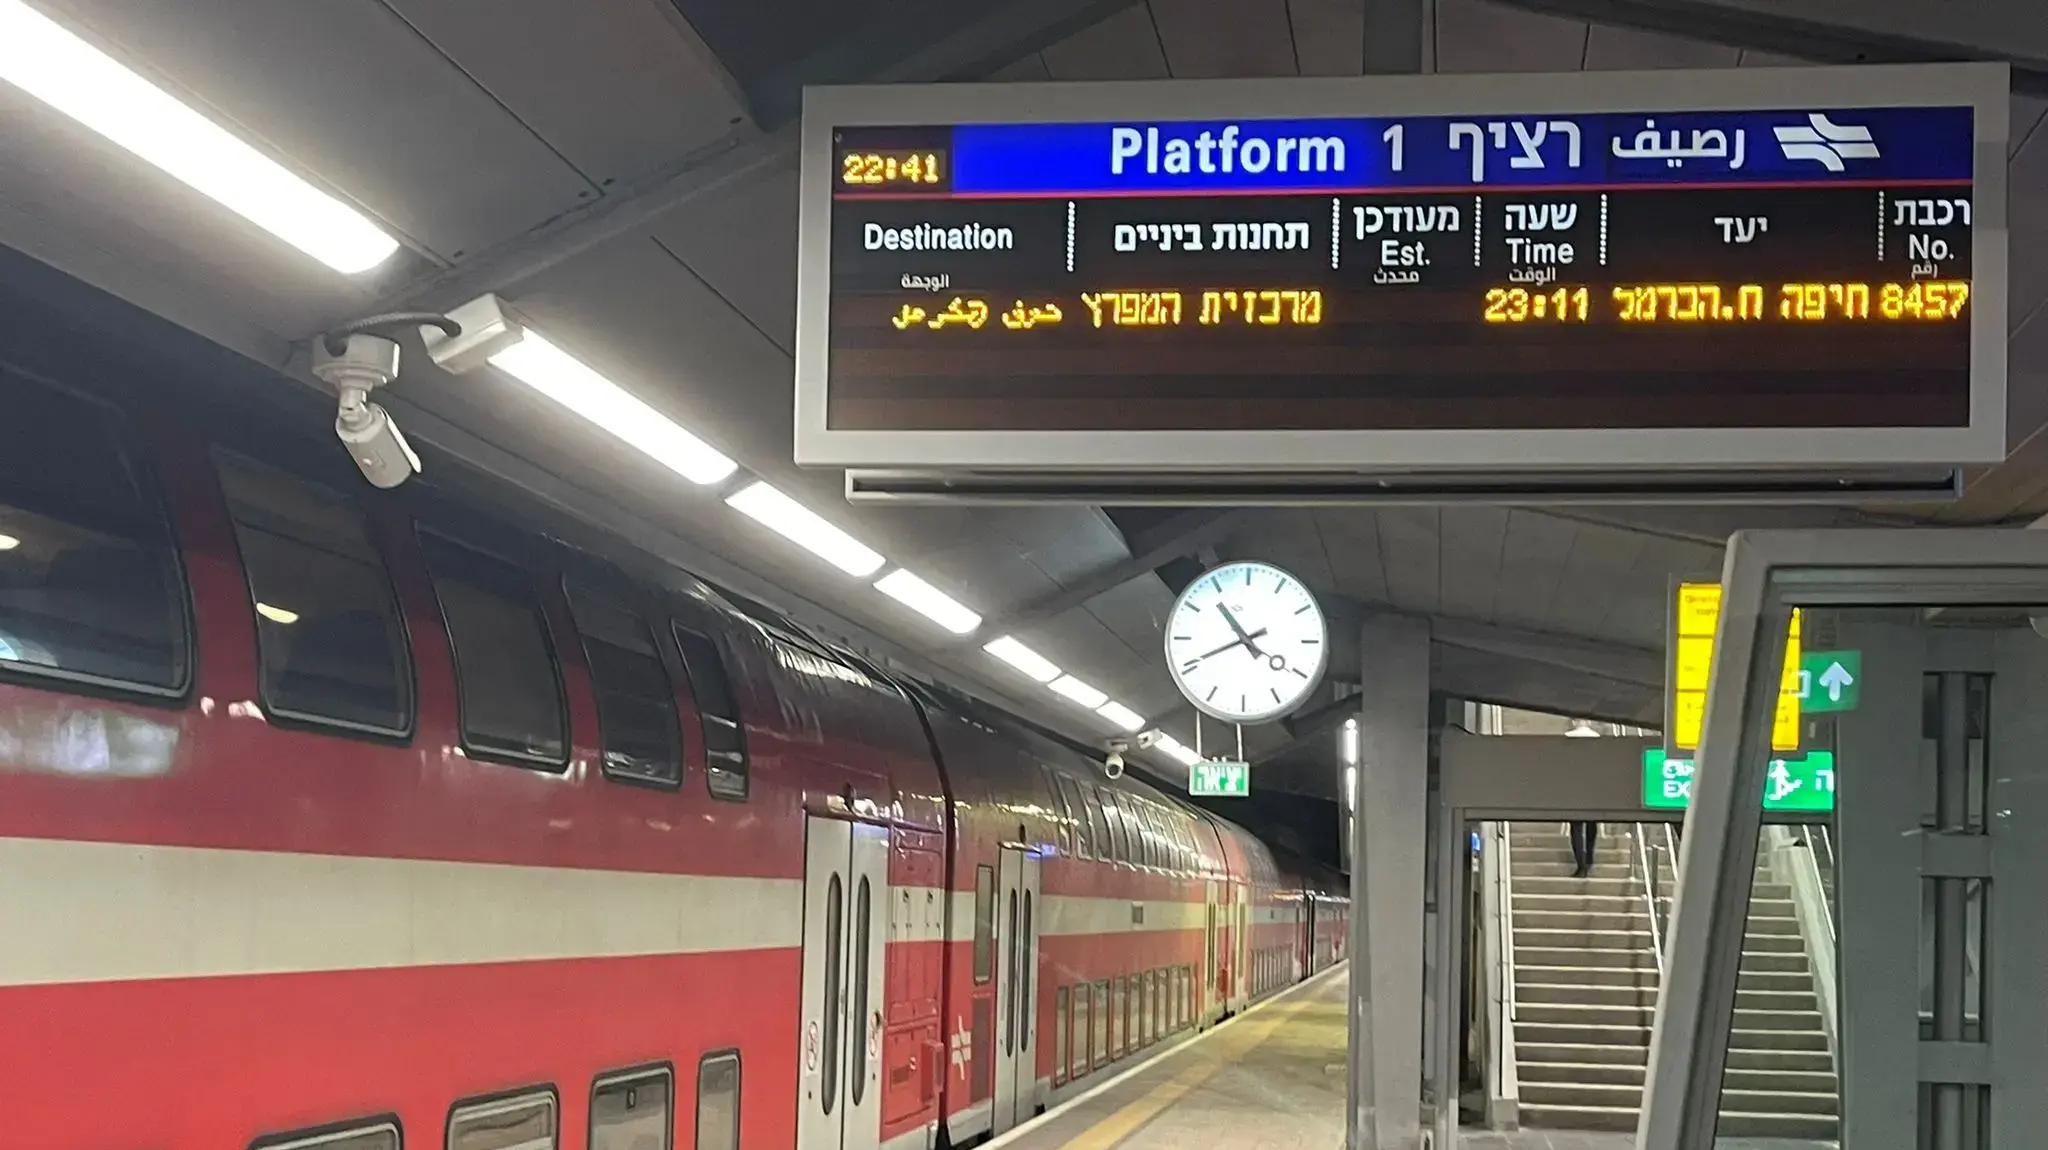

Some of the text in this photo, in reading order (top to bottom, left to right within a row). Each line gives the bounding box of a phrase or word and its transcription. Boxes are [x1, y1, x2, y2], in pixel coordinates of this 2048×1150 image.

[1111, 124, 1403, 174] Platform 1
[1448, 120, 1581, 182] רציף
[1612, 119, 1745, 169] رصيف
[843, 154, 939, 184] 22:41
[1352, 205, 1460, 240] מעודכן
[1505, 203, 1578, 231] שעה
[1893, 199, 1971, 226] רכבת
[864, 222, 1013, 251] Destination
[1114, 222, 1309, 252] תחנות ביניים
[1714, 216, 1769, 243] יעד
[1381, 239, 1431, 266] Est.
[1505, 237, 1574, 264] Time
[1908, 234, 1955, 261] No.
[901, 273, 950, 292] الوجهة
[1508, 266, 1556, 286] الوقت
[1911, 260, 1938, 280] رقم
[1081, 290, 1322, 328] מרכזית המפרץ
[1484, 286, 1589, 322] 23:11
[1780, 283, 1870, 320] חיפה
[1880, 283, 1970, 320] 8457
[1663, 780, 1691, 798] EX
